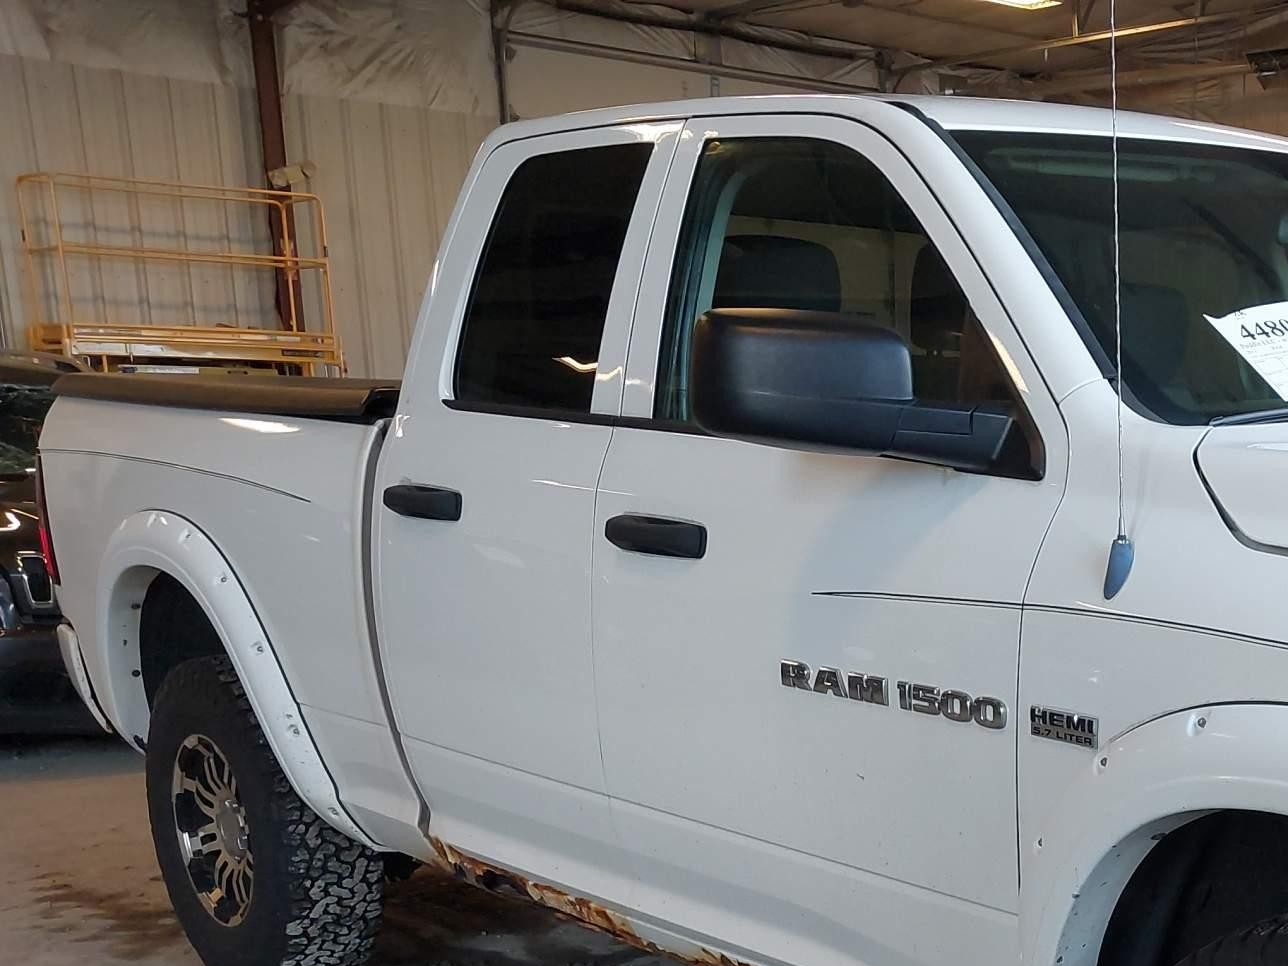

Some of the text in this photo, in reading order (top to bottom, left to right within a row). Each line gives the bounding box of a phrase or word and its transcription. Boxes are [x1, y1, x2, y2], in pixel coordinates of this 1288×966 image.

[781, 659, 1007, 729] RAM 1500
[1030, 706, 1094, 734] HEMI
[1033, 726, 1092, 746] 5.7 LITER
